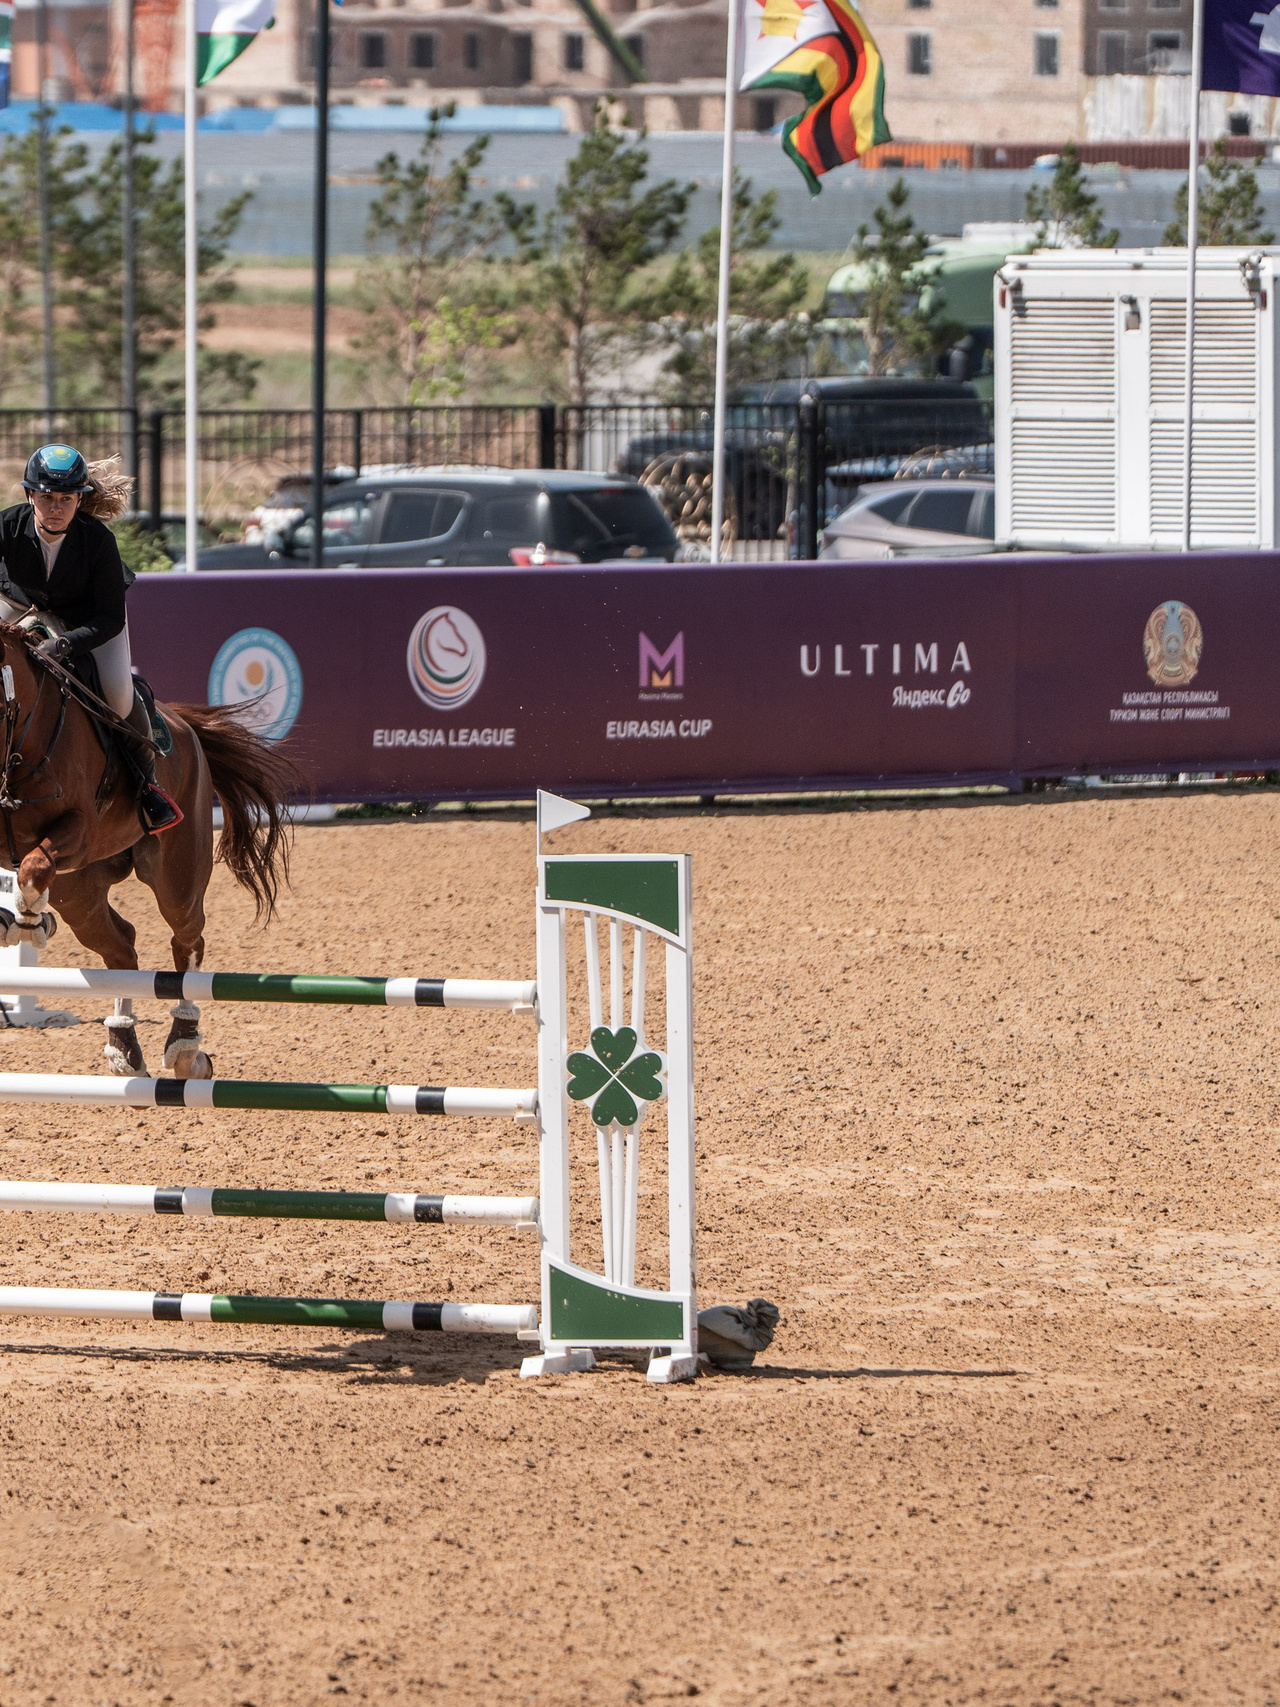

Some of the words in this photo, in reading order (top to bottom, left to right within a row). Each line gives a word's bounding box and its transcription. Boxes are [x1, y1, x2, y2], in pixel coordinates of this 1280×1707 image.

[800, 641, 971, 676] ULTIMA
[893, 686, 946, 708] Яндекс
[946, 680, 971, 709] Go
[372, 728, 446, 747] EURASIA
[448, 727, 517, 747] LEAGUE
[606, 720, 677, 739] EURASIA
[679, 719, 713, 738] CUP
